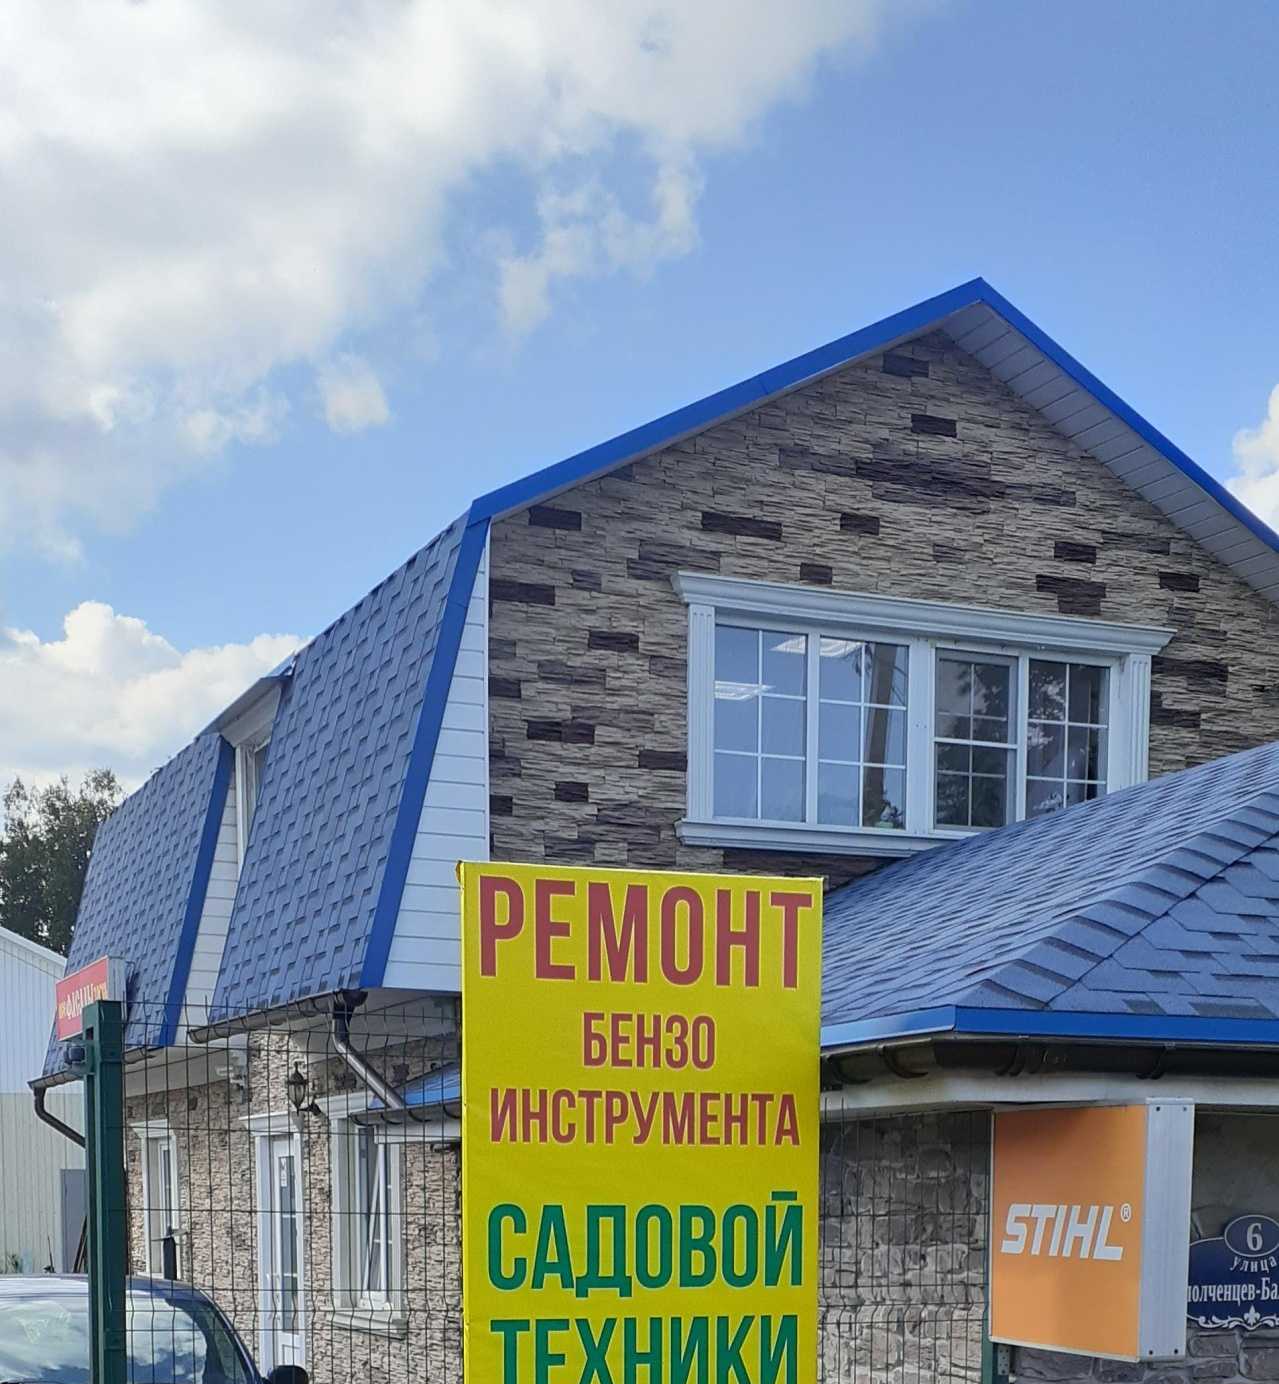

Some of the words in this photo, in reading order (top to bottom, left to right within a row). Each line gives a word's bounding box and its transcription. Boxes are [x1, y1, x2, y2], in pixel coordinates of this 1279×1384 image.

[479, 875, 813, 989] РЕМОНТ
[582, 1011, 716, 1069] БЕНЗО
[490, 1087, 800, 1146] ИНСТРУМЕНТА
[488, 1190, 804, 1298] САДОВОЙ
[1246, 1222, 1263, 1251] 6
